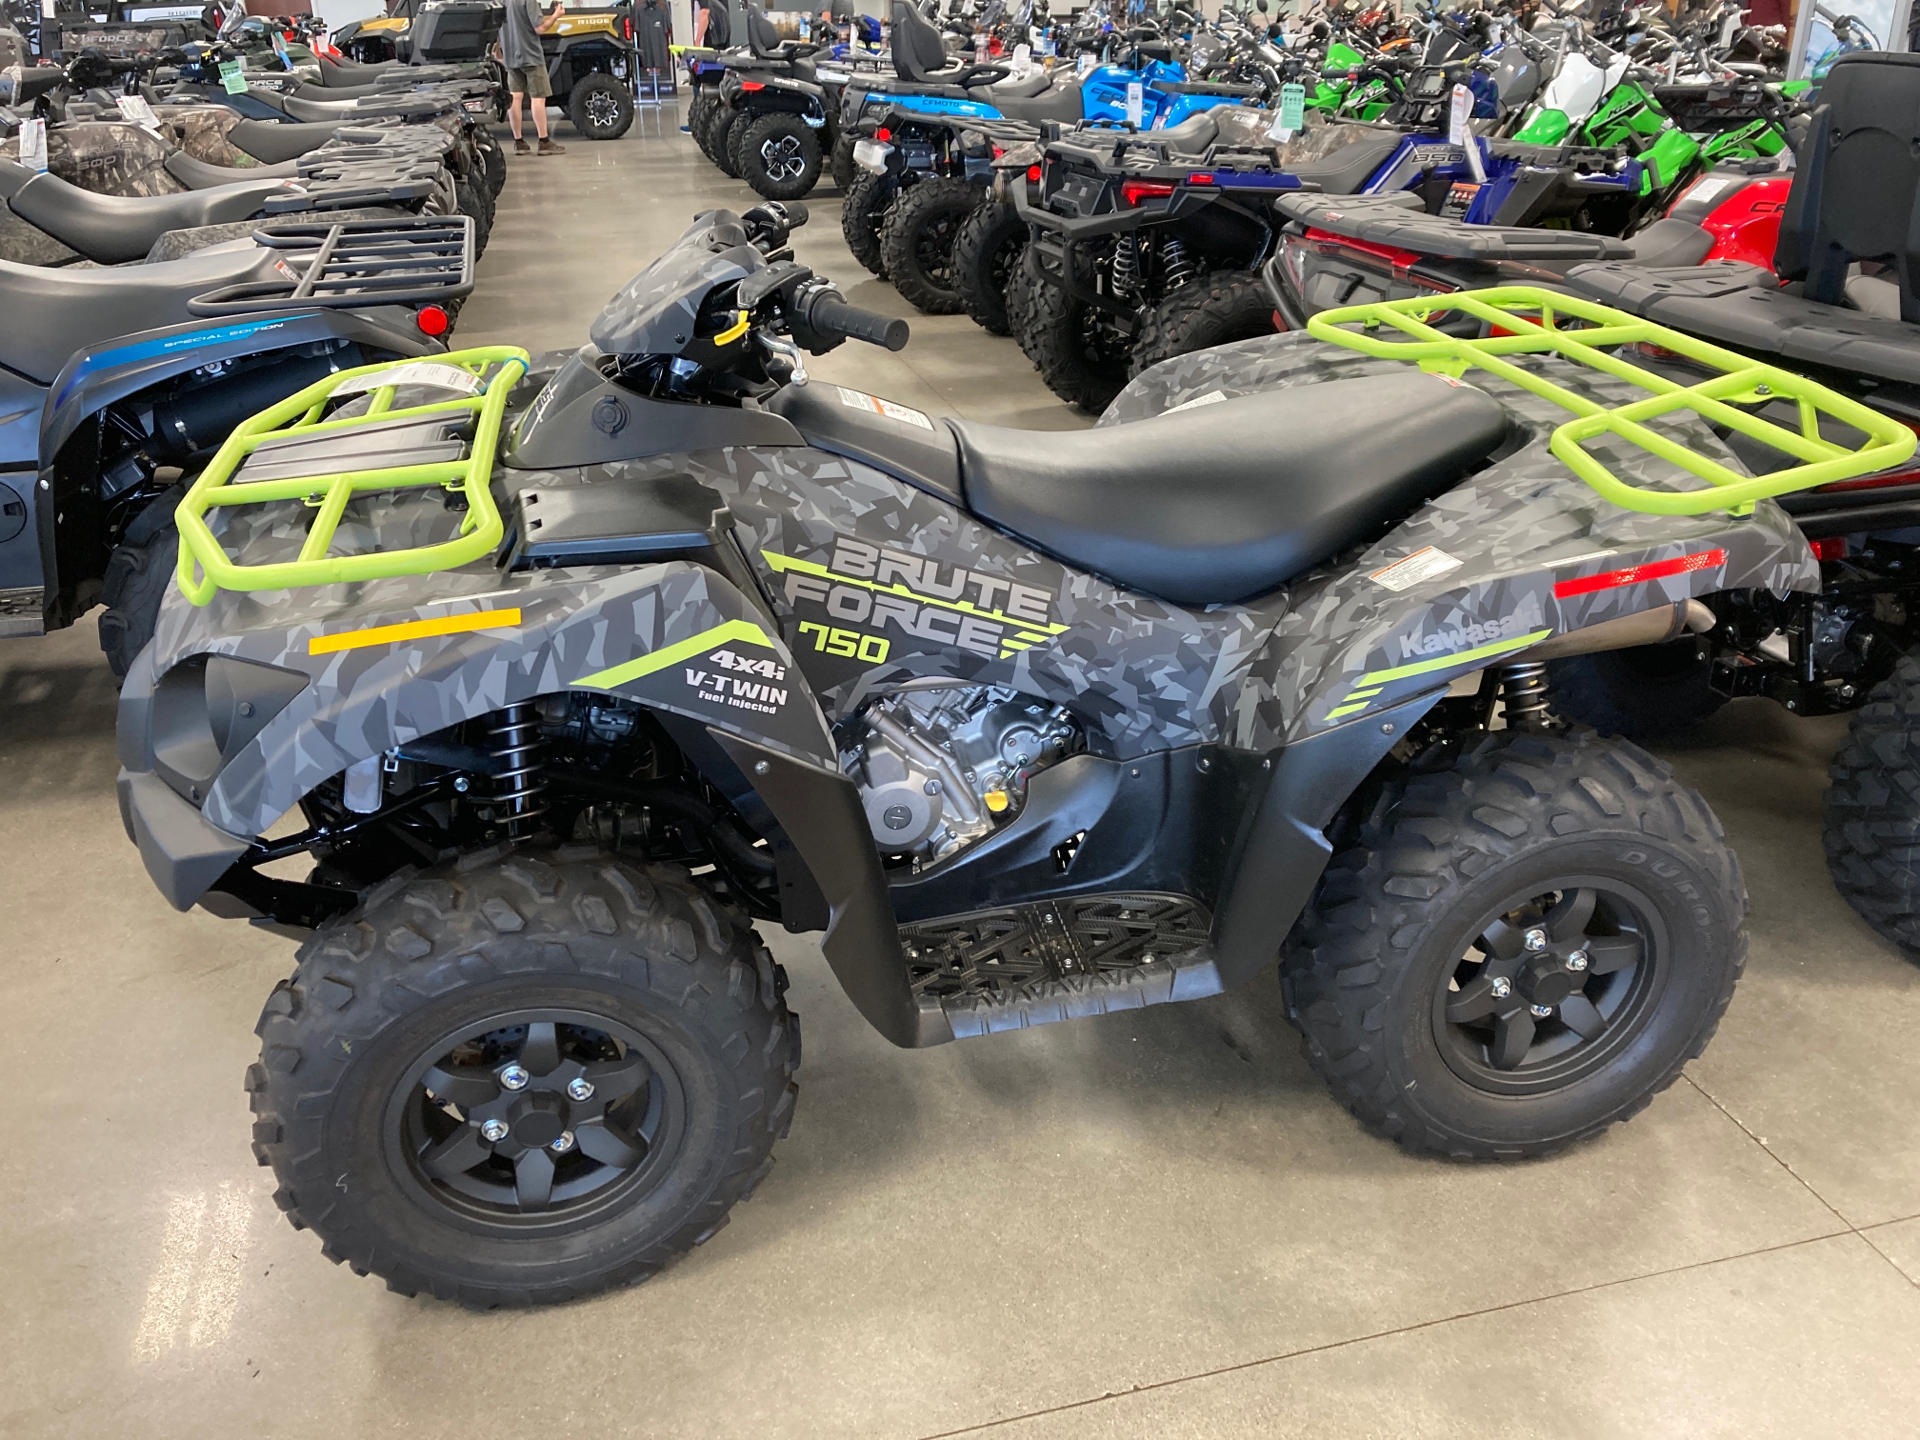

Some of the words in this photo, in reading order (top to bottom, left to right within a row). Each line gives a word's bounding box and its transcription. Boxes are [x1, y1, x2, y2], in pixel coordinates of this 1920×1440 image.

[773, 77, 799, 88] CFMOTO
[922, 99, 960, 108] CFMOTO
[1607, 99, 1635, 118] KLX
[1723, 125, 1754, 146] KLX
[1411, 153, 1465, 165] 850
[164, 333, 225, 348] SPECIAL
[229, 322, 284, 336] EDITION
[831, 537, 1051, 623] BRUTE
[784, 573, 1003, 655] FORCE
[799, 620, 890, 664] 750
[1399, 602, 1544, 659] Kawasaki
[709, 650, 786, 681] 4x4i
[685, 668, 788, 706] V-TWIN
[698, 690, 725, 704] Fuel
[727, 697, 777, 715] Injected
[1615, 850, 1712, 927] DURO
